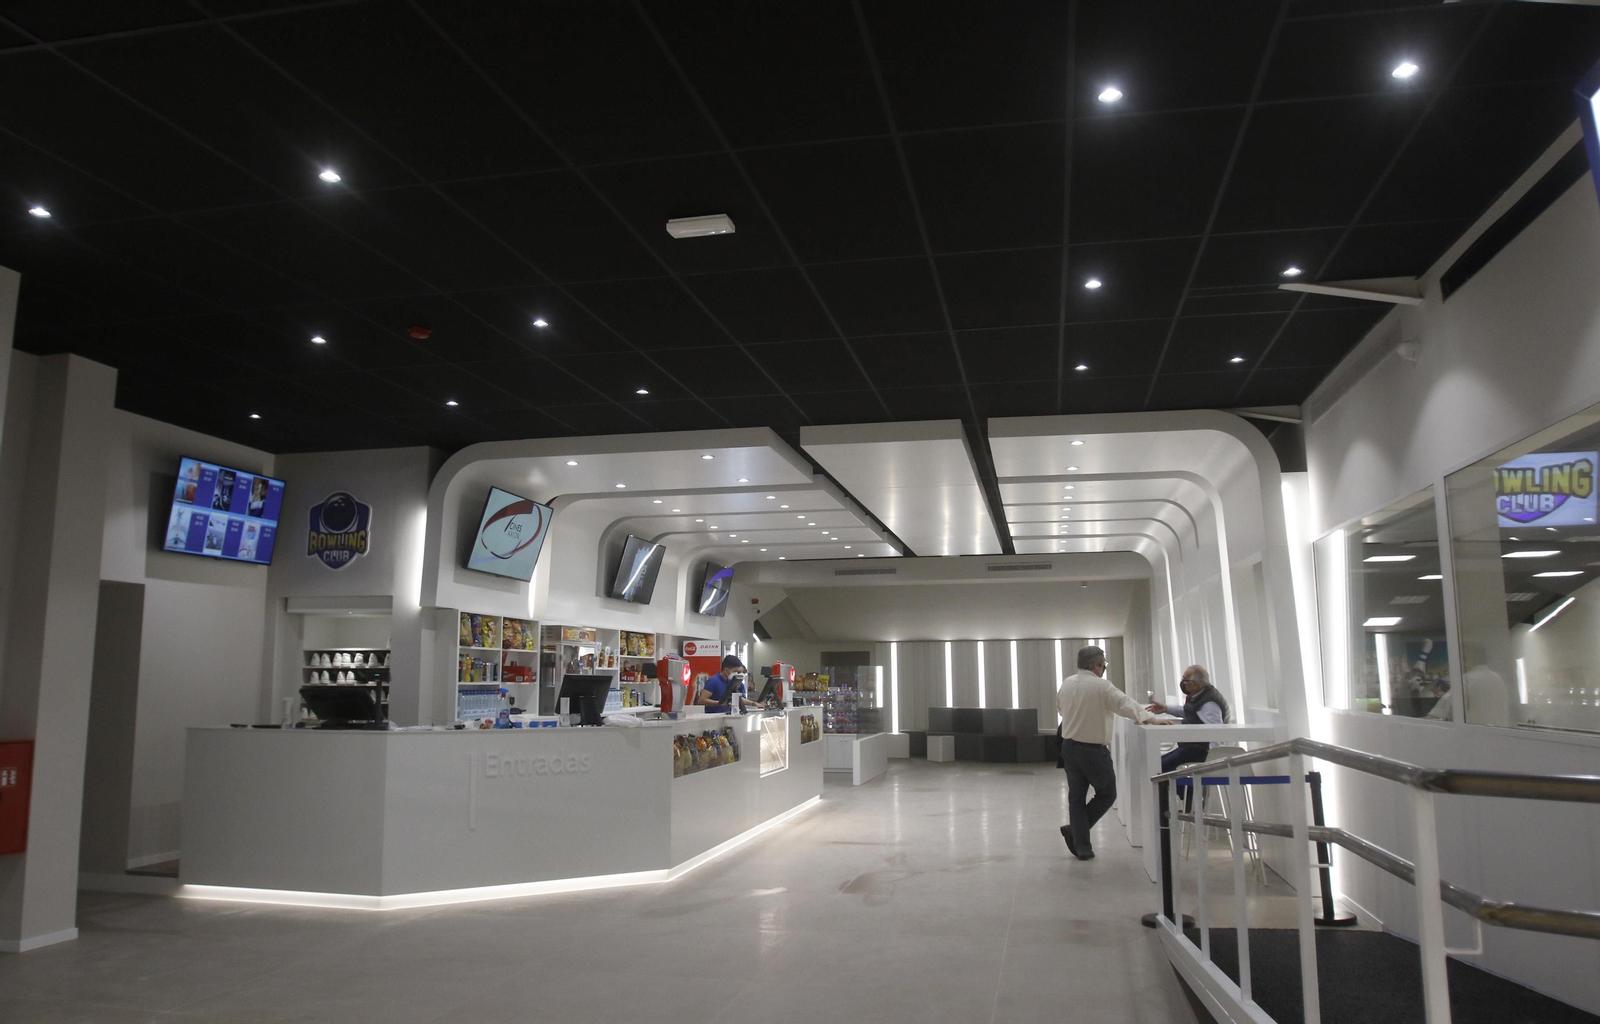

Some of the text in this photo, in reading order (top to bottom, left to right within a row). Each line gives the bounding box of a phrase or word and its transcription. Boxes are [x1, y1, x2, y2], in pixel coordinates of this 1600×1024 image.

[1496, 493, 1555, 514] CLUB
[308, 530, 367, 555] BOWLING
[323, 550, 350, 562] CLUB
[484, 749, 591, 778] Entradas
